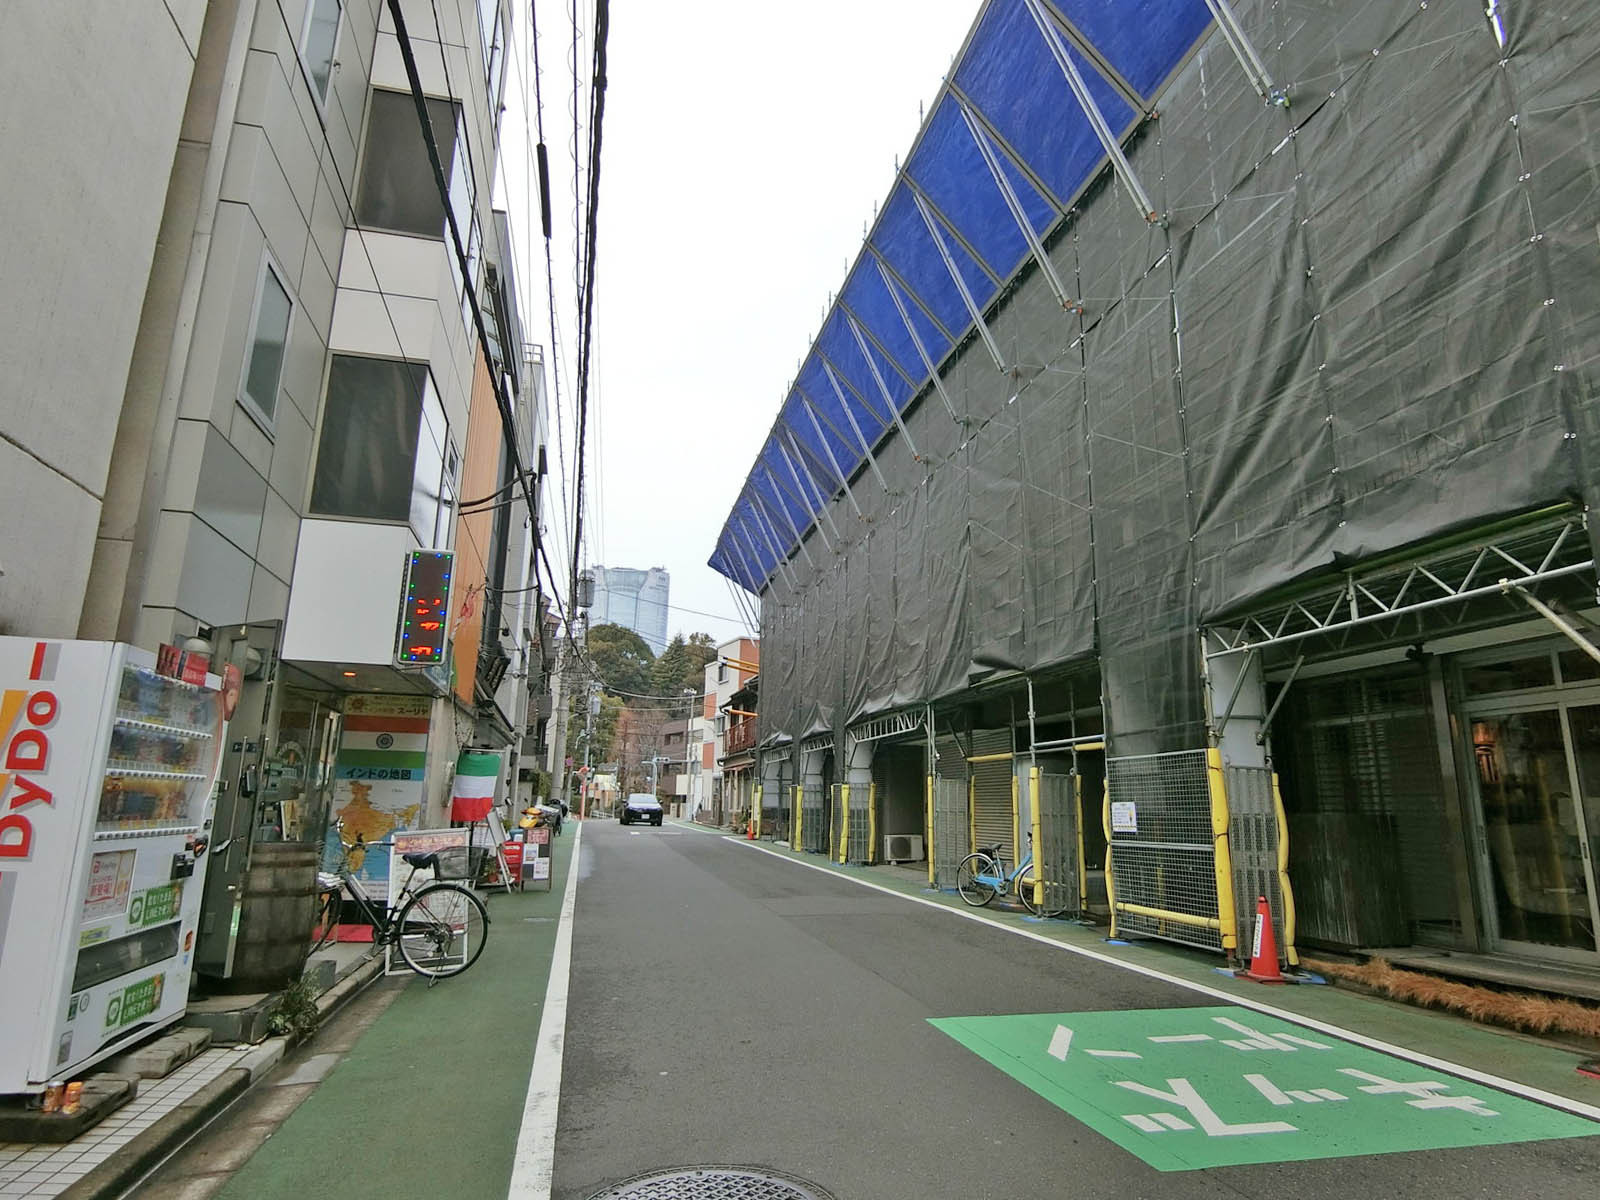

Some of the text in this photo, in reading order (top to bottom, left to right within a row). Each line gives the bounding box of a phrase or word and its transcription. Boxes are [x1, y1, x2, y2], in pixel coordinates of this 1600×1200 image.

[0, 691, 58, 858] DyDo
[346, 767, 412, 780] インドの地図
[1108, 1067, 1501, 1137] キッズ
